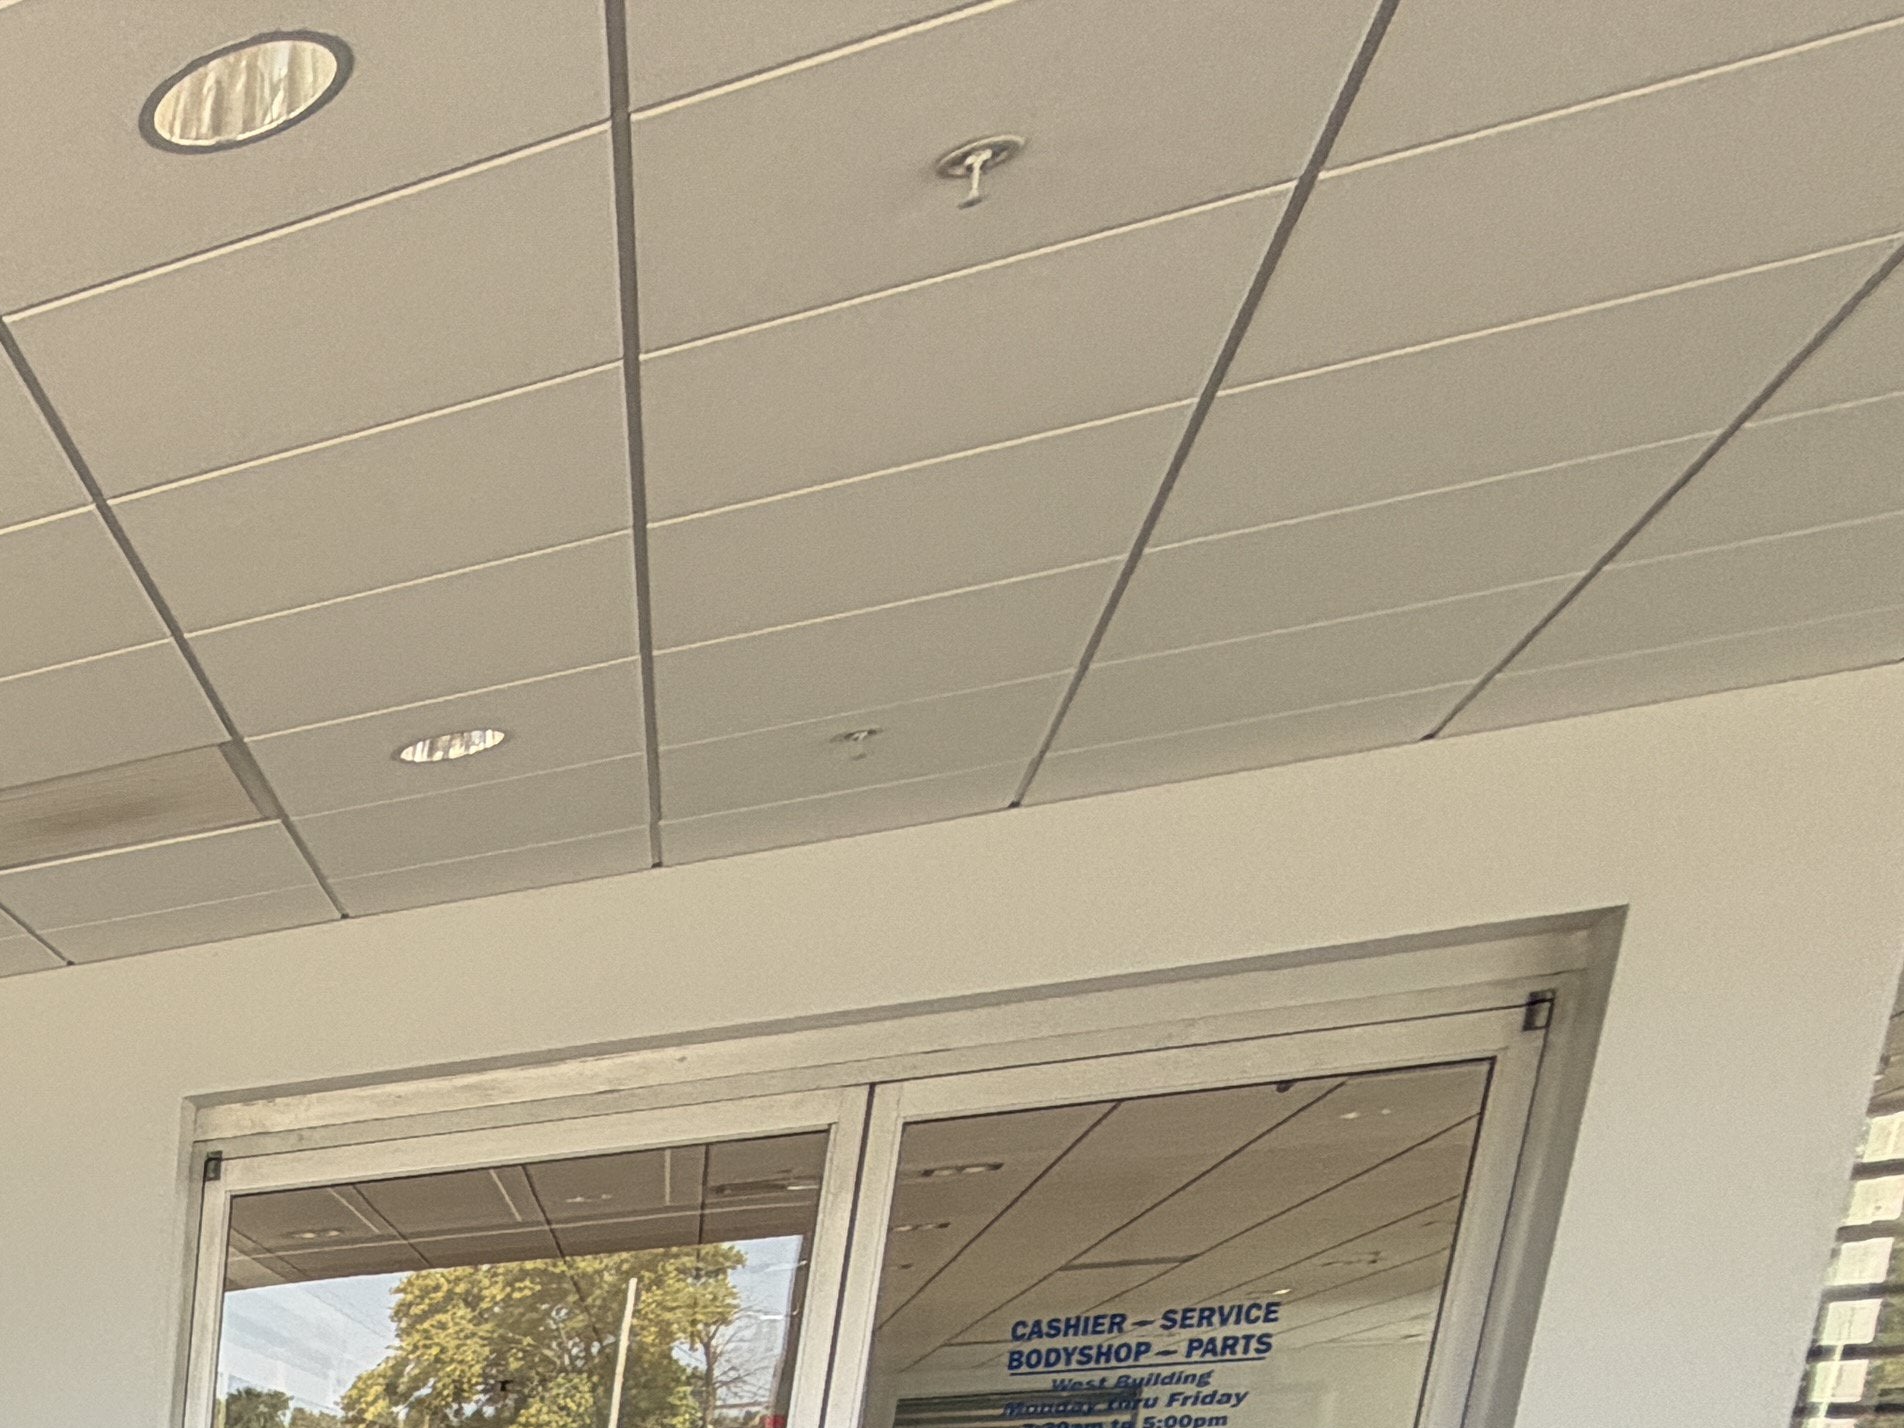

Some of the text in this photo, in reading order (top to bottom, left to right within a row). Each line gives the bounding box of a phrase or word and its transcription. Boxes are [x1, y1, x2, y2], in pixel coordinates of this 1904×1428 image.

[1011, 1313, 1127, 1342] CASHIER
[1159, 1301, 1282, 1331] SERVICE
[1007, 1341, 1152, 1371] BODYSHOP
[1185, 1333, 1273, 1359] PARTS
[1051, 1369, 1215, 1391] West Building
[1107, 1397, 1158, 1411] thru
[1165, 1389, 1249, 1409] Friday
